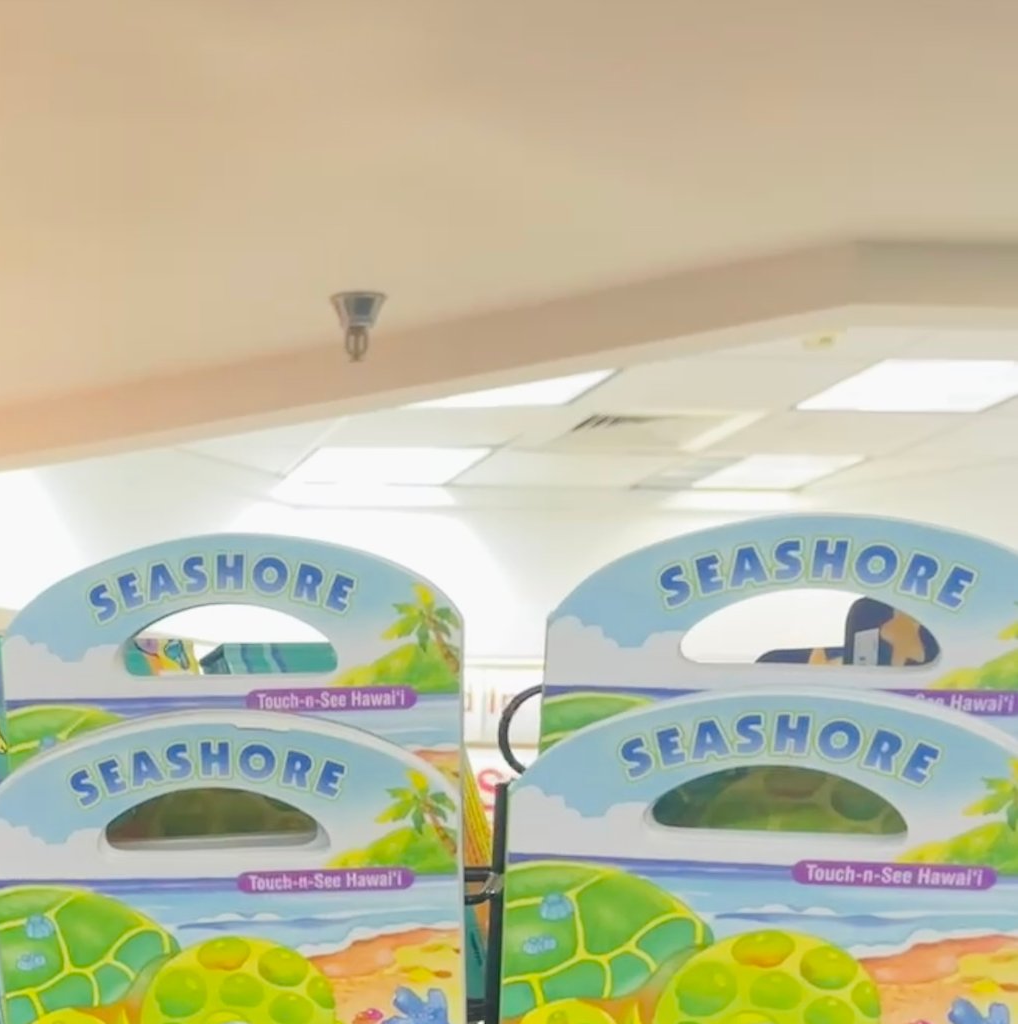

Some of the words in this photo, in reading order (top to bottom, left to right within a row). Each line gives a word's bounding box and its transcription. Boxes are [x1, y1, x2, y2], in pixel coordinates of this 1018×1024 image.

[88, 554, 356, 621] SEASHORE
[660, 539, 975, 610] SEASHORE
[257, 691, 346, 710] Touch-n-See
[69, 741, 347, 806] SEASHORE
[620, 714, 939, 786] SEASHORE
[249, 873, 341, 892] Touch-n-See
[806, 864, 913, 885] Touch-n-See
